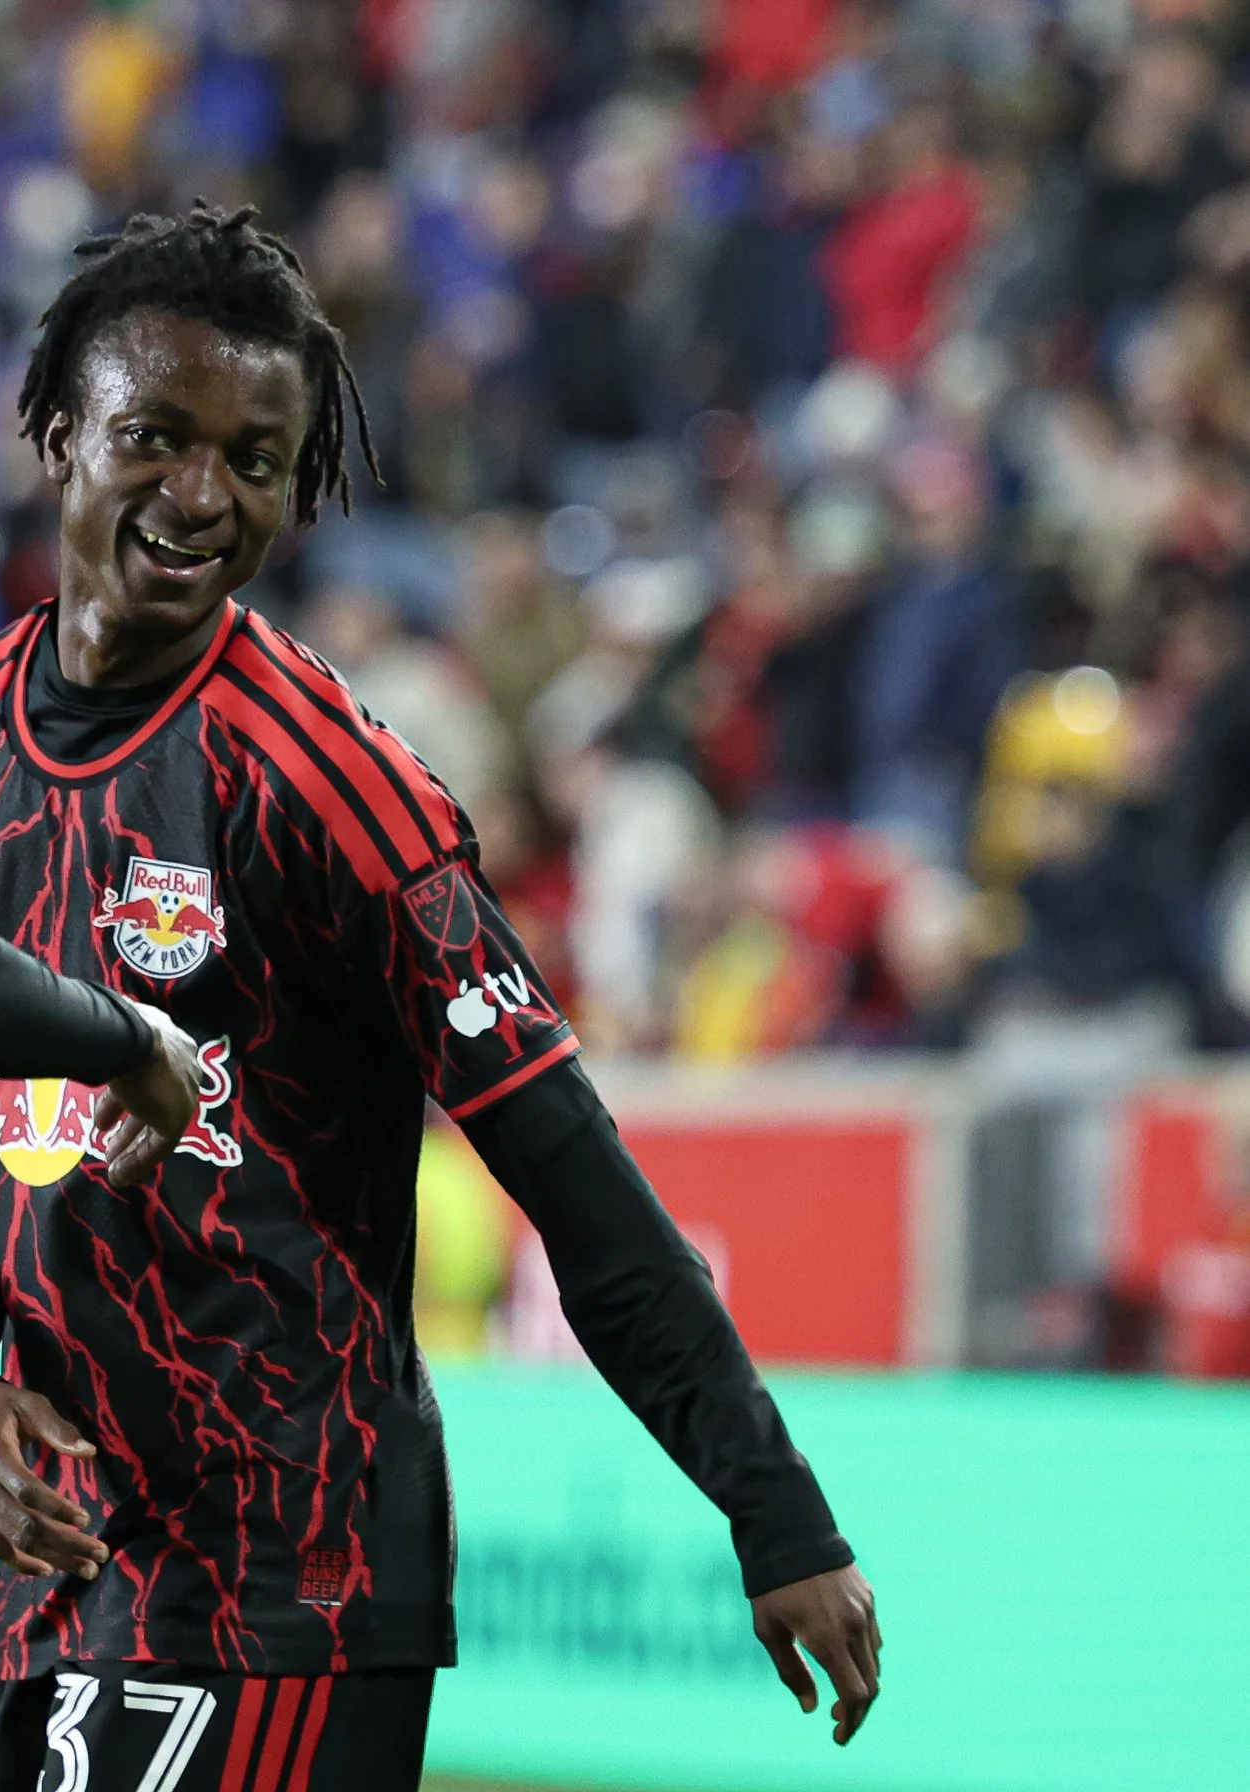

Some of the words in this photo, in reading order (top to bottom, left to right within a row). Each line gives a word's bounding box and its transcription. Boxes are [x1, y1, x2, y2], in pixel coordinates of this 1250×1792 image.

[410, 879, 447, 910] MLS
[124, 933, 156, 965] NEW
[160, 940, 198, 971] YORK
[483, 963, 531, 1014] tv
[302, 1565, 341, 1581] RUNS
[306, 1550, 345, 1565] RED
[301, 1581, 339, 1598] DEEP
[36, 1673, 218, 1792] 37
